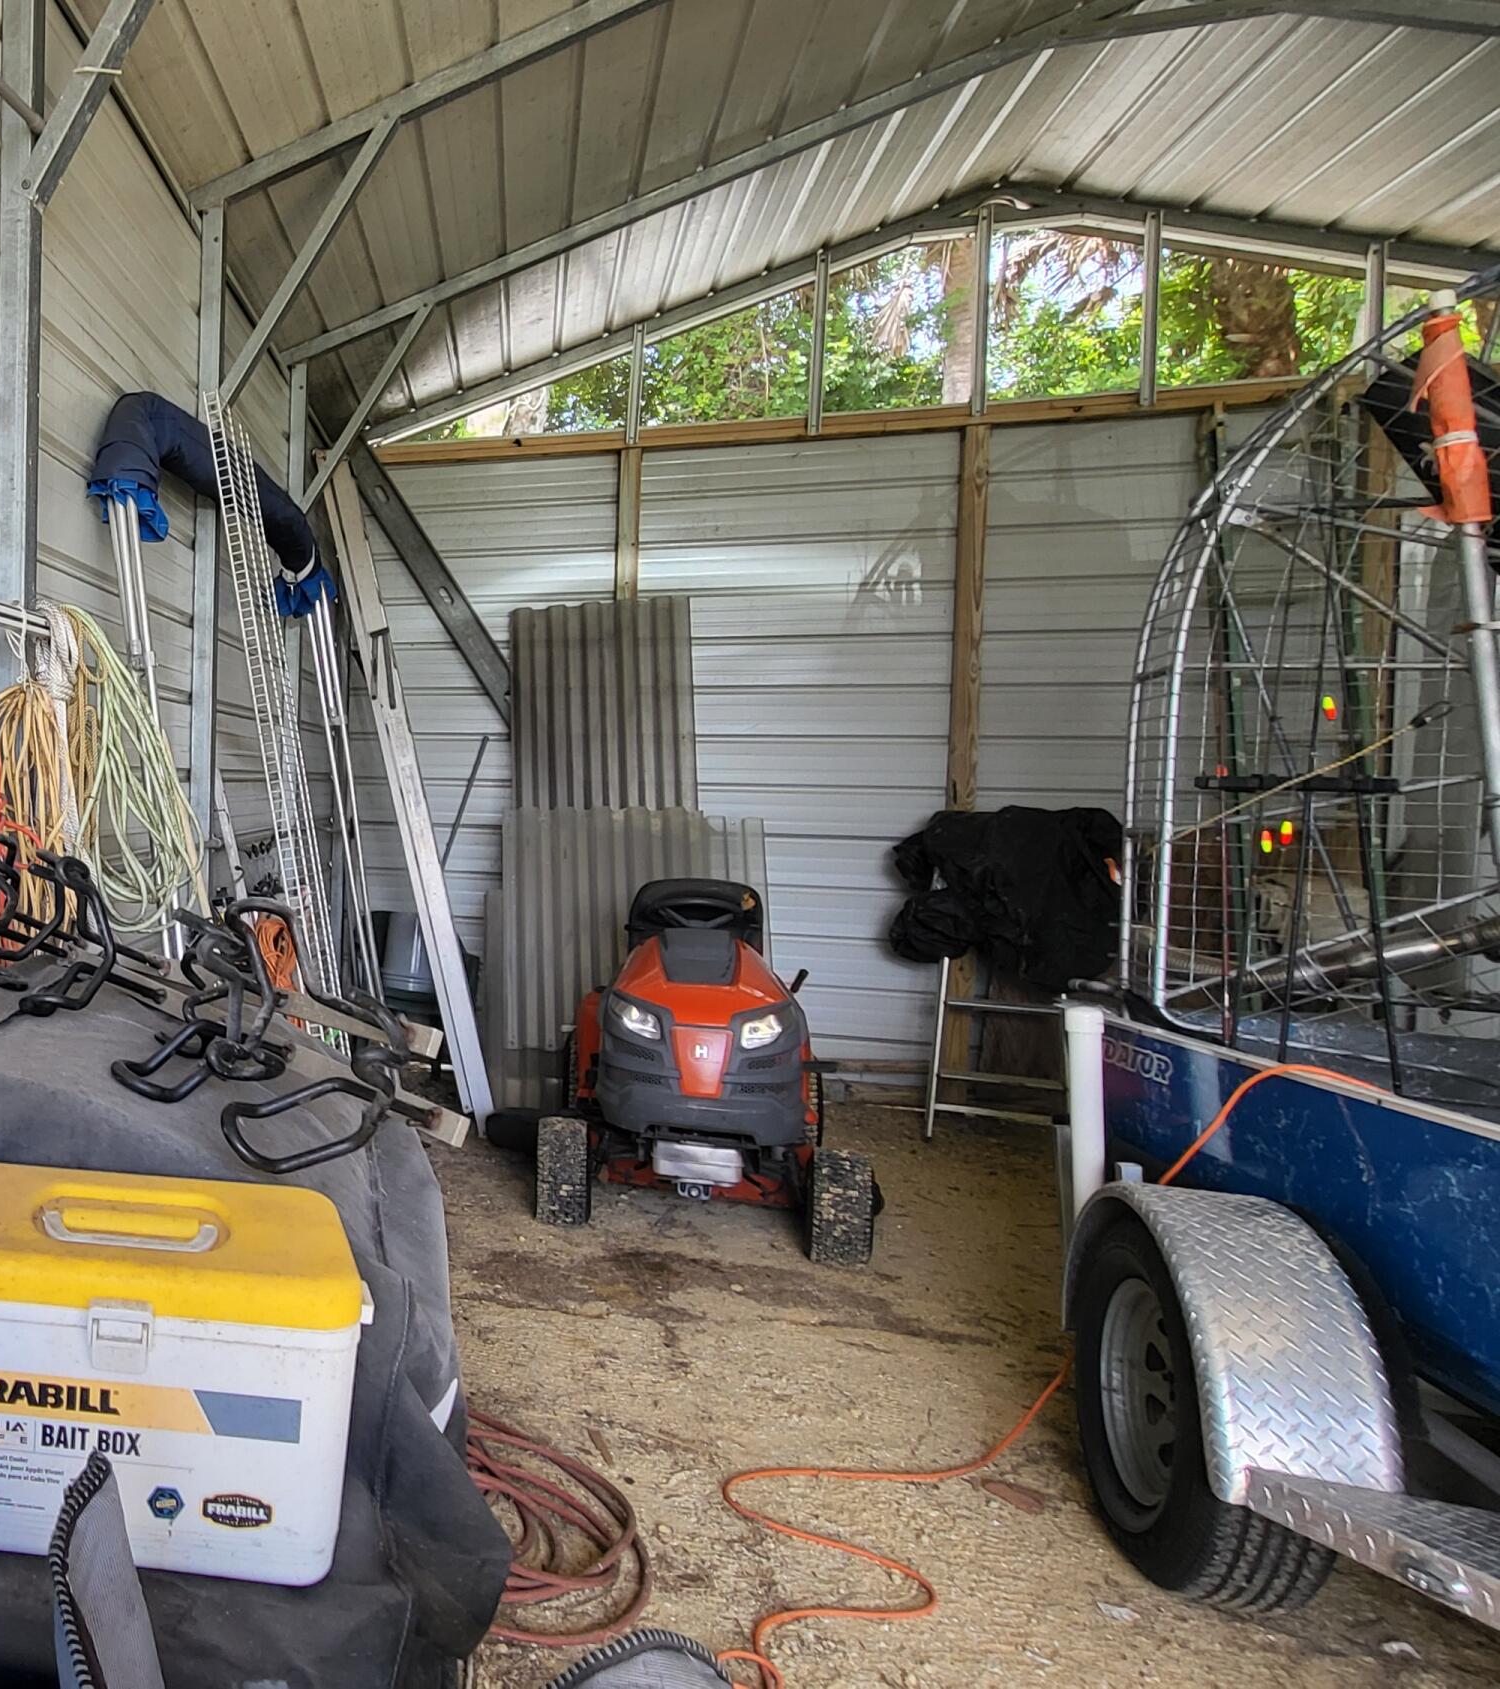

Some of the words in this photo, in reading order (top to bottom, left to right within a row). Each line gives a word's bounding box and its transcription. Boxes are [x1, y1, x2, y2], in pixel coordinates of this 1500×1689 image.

[695, 1044, 708, 1059] H
[41, 1424, 90, 1451] BAIT
[97, 1430, 141, 1457] BOX
[206, 1502, 268, 1521] FRABILL
